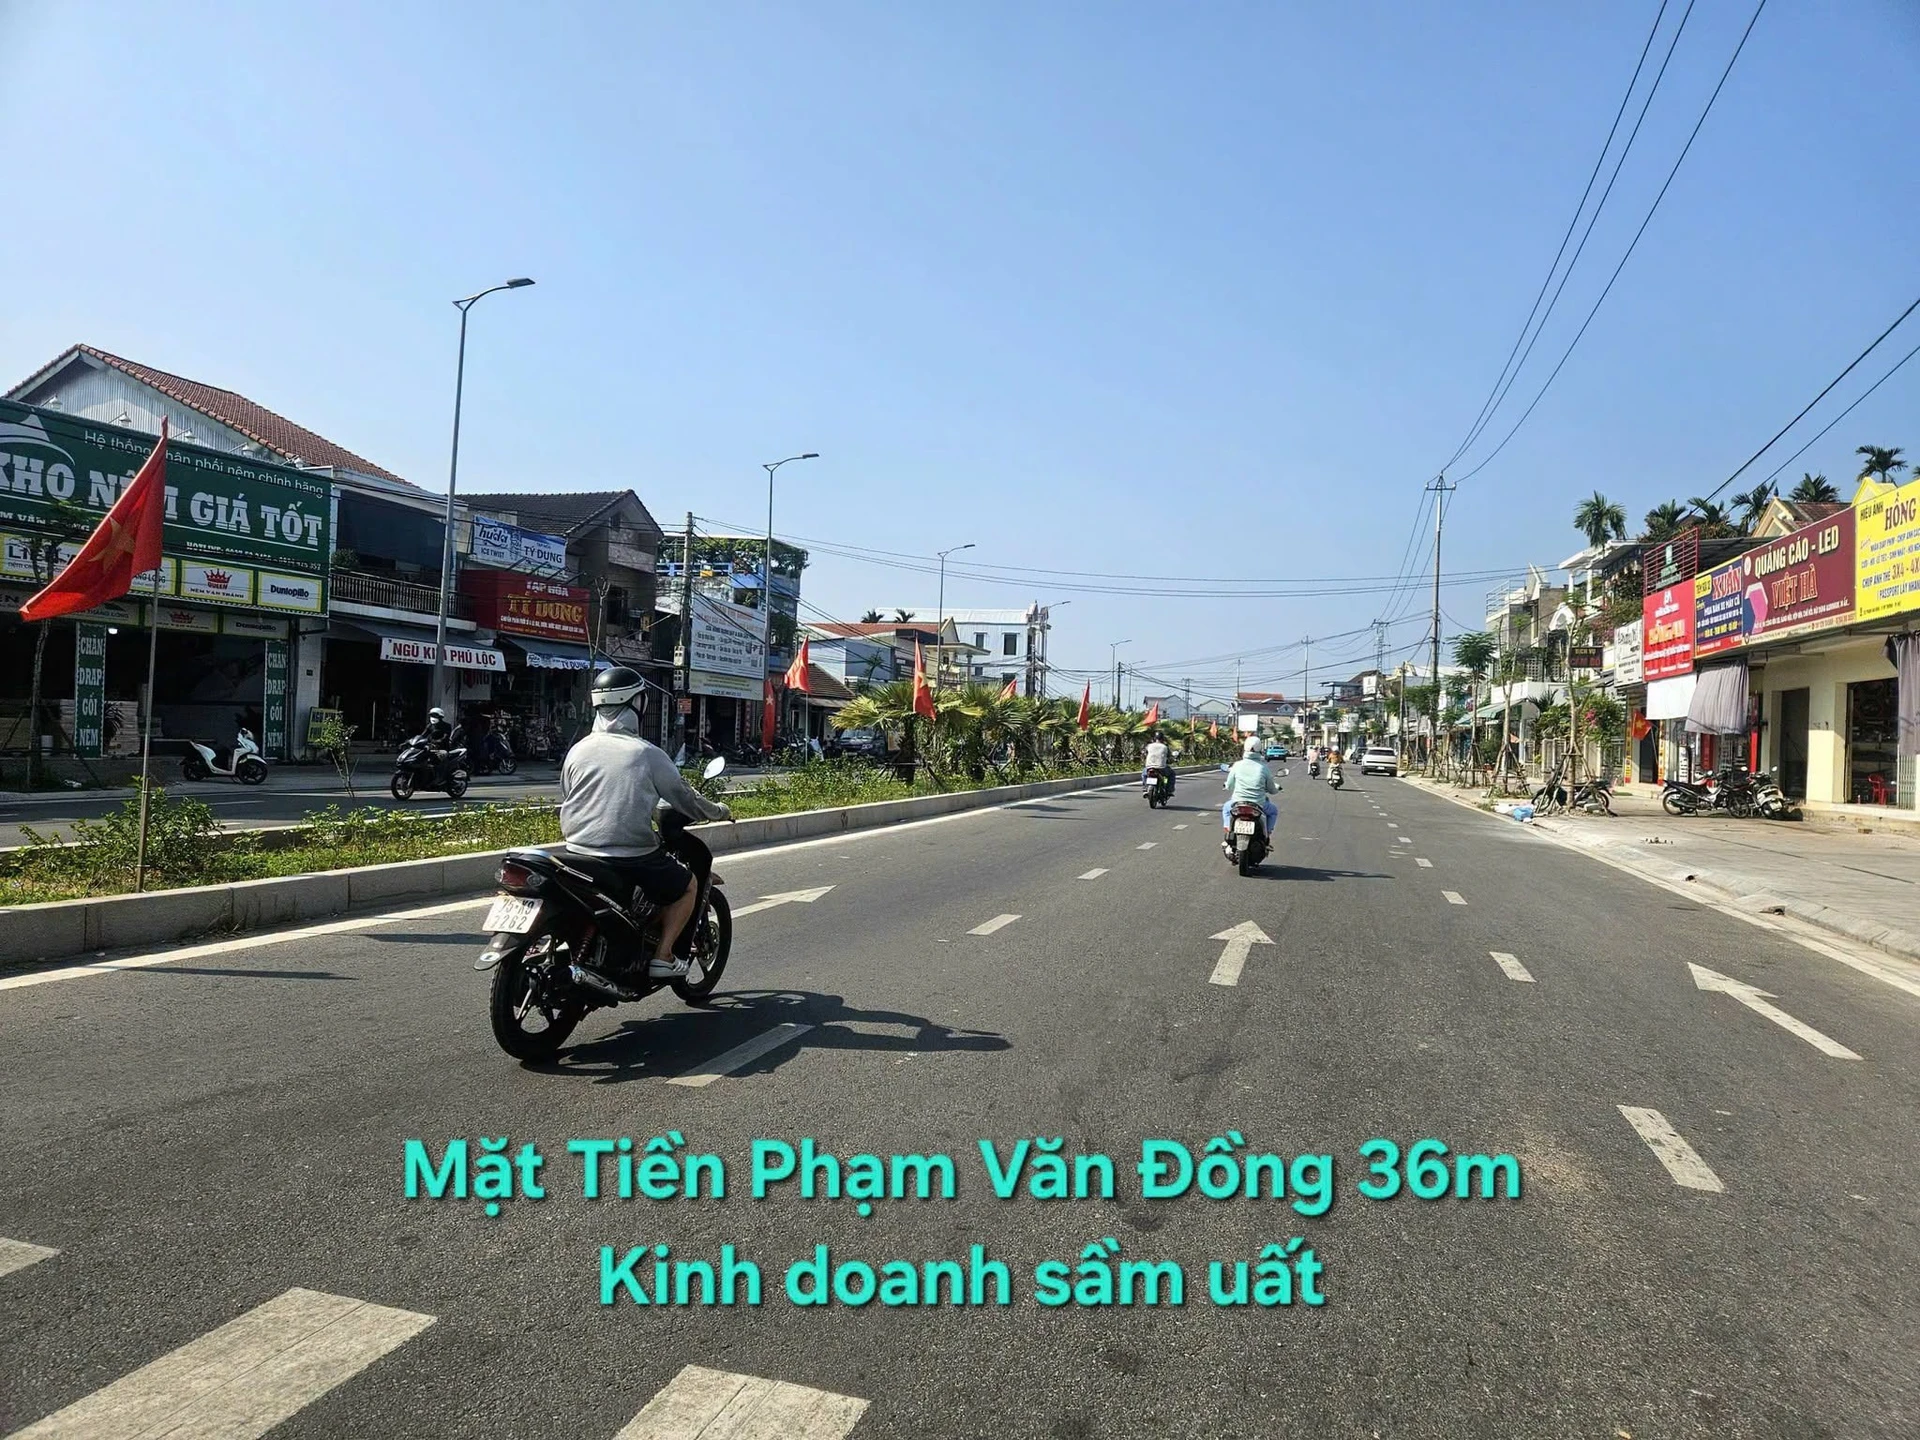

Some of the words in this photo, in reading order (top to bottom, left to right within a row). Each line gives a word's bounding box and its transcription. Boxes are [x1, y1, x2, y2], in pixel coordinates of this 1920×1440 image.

[85, 430, 106, 450] Hệ
[166, 450, 191, 465] hân
[195, 457, 223, 471] phối
[227, 466, 255, 480] nệm
[258, 471, 292, 487] chính
[295, 479, 324, 499] hãng
[190, 492, 250, 534] GIÁ
[261, 501, 322, 546] TỐT
[1885, 492, 1917, 531] HỒNG
[536, 549, 563, 564] DUNG
[1755, 545, 1786, 579] QUẢNG
[1788, 536, 1808, 565] CÁO
[1818, 525, 1839, 555] LED
[207, 582, 228, 590] QUEEN
[1771, 571, 1798, 610] VIỆT
[393, 642, 420, 658] NGŨ
[450, 648, 473, 664] PHÚ
[475, 651, 496, 668] LỘC
[79, 667, 102, 686] DRAP
[267, 679, 286, 695] DRAP
[82, 692, 98, 716] GỐI
[270, 700, 283, 721] GỐI
[79, 725, 98, 750] NỆM
[267, 728, 283, 751] NỆM
